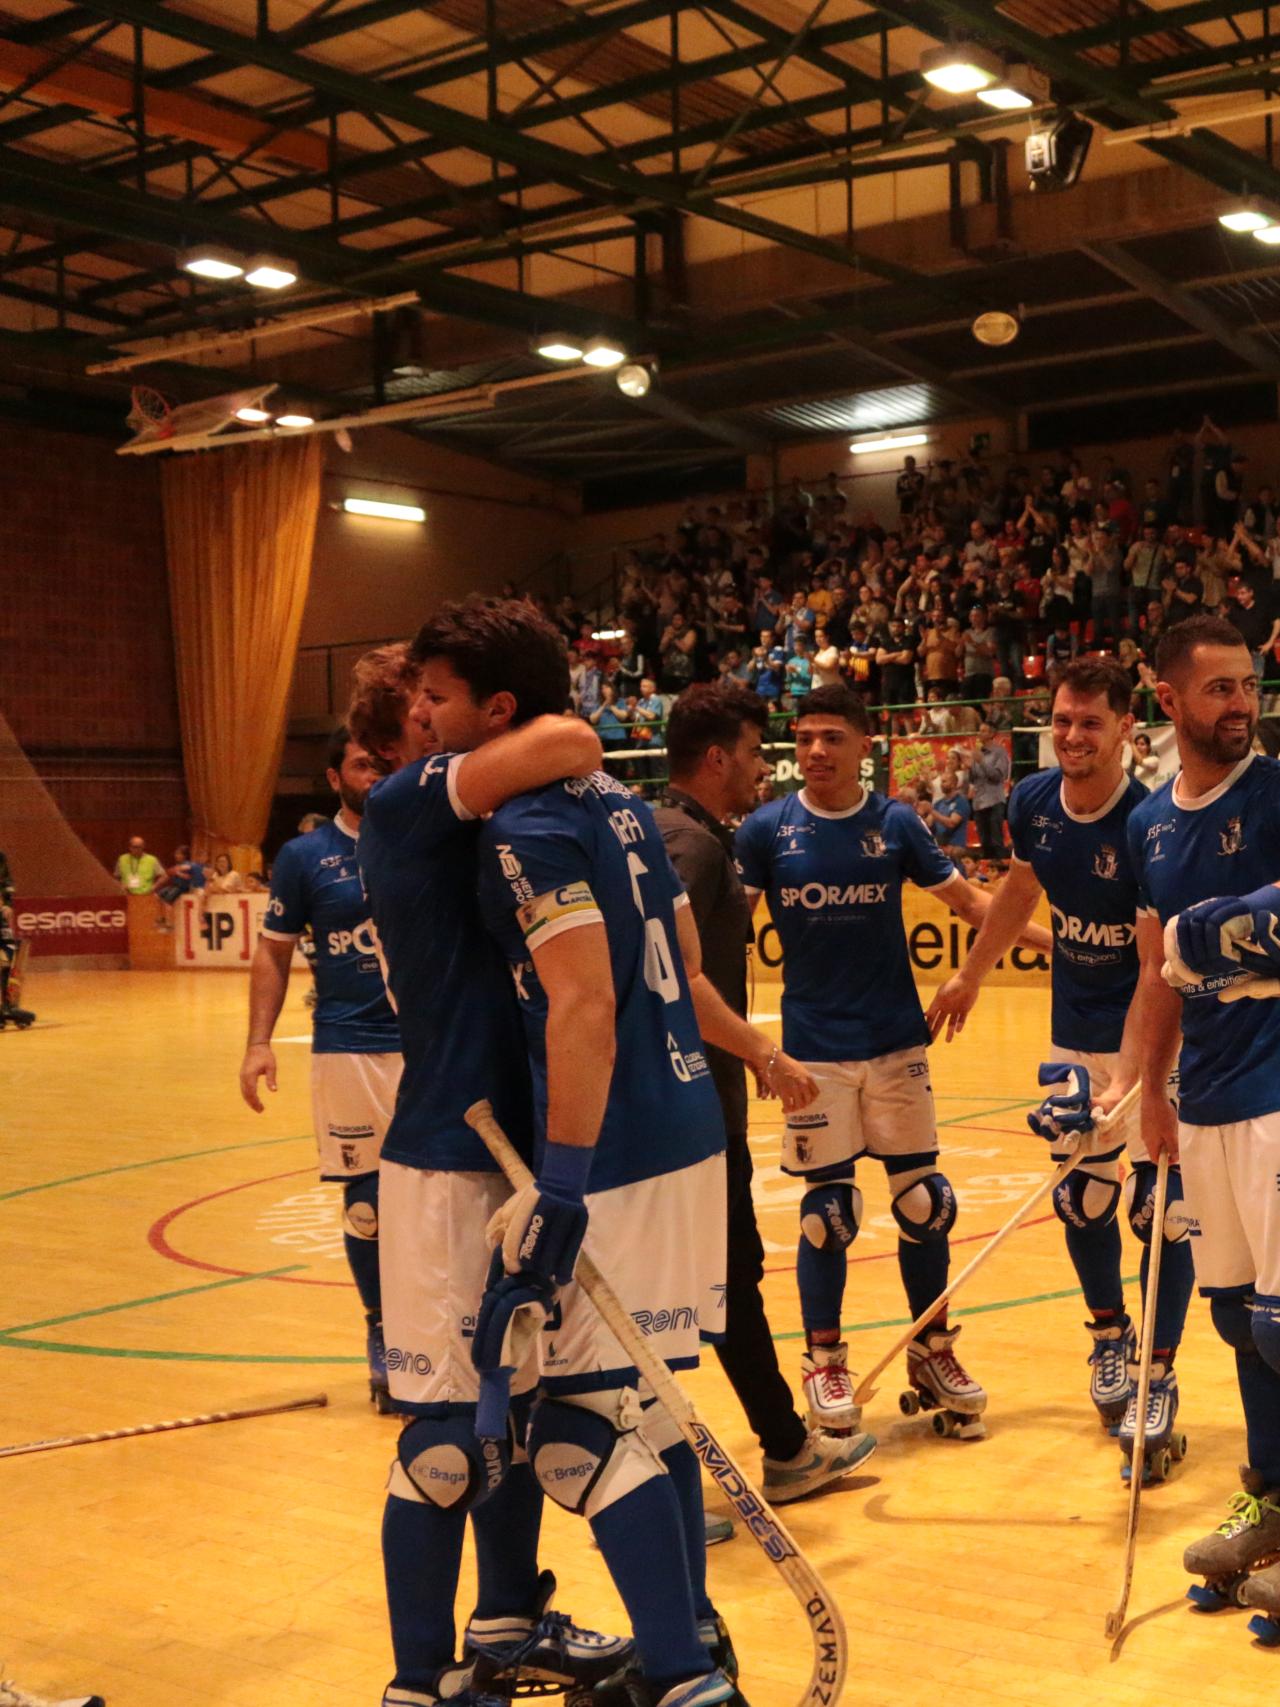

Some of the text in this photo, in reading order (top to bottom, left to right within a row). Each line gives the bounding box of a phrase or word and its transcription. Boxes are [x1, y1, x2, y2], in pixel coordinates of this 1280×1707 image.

[780, 882, 887, 910] SPORMEX
[17, 910, 127, 930] esneca
[1050, 902, 1138, 947] ORMEX
[824, 1197, 852, 1242] Reno
[928, 1185, 952, 1232] Reno
[519, 1214, 544, 1261] Reno
[688, 1421, 800, 1563] SPECIAL
[804, 1590, 839, 1707] ZEMAD
